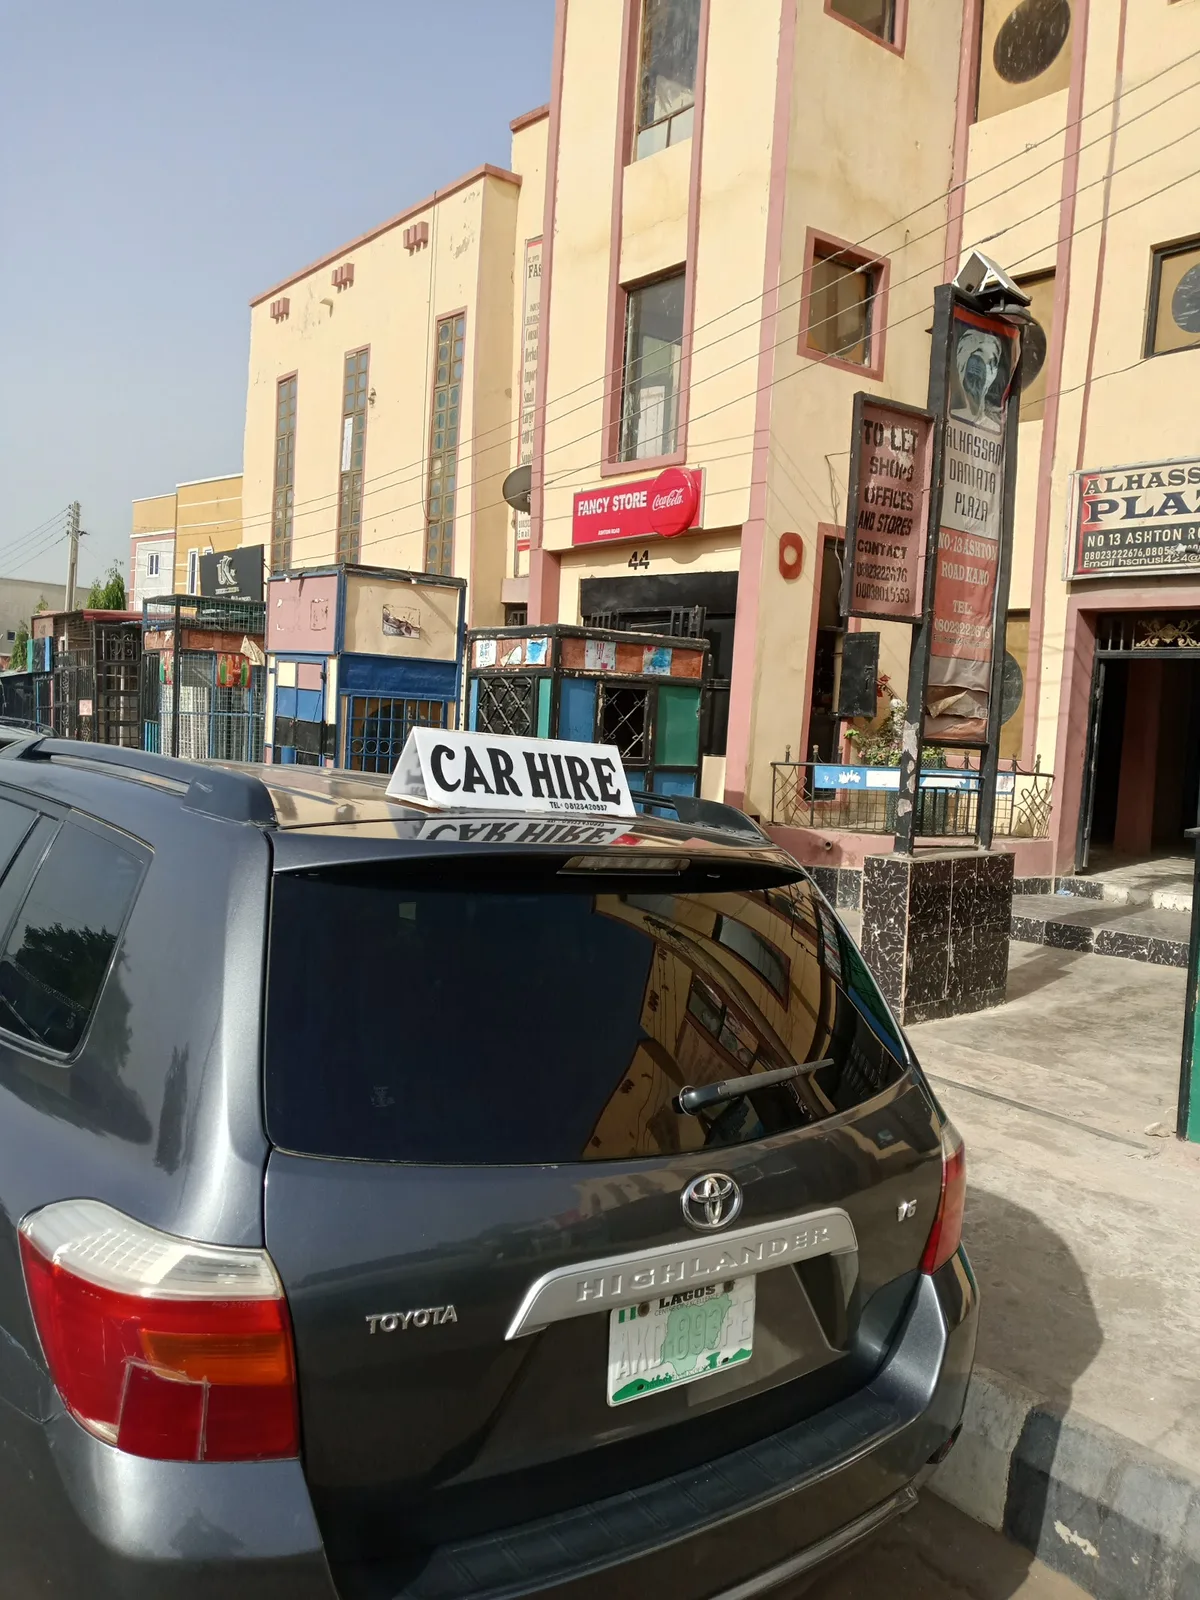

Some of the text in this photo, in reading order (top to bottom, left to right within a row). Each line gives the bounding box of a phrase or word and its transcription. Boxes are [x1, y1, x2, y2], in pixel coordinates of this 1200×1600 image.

[863, 419, 919, 454] TO LET
[946, 425, 1002, 466] ALHASSAN
[869, 456, 914, 482] SHOPS
[949, 457, 996, 495] DANTATA
[577, 496, 610, 516] FANCY
[612, 490, 648, 512] STORE
[864, 485, 913, 511] OFFICES
[954, 491, 988, 522] PLAZA
[1083, 490, 1200, 523] PLA
[858, 511, 913, 536] AND STORES
[857, 539, 908, 559] CONTACT
[963, 538, 998, 562] ASHTON
[1087, 535, 1104, 547] NO
[1108, 533, 1121, 546] 13
[1125, 528, 1182, 544] ASHTON
[627, 549, 650, 571] 44
[941, 560, 990, 586] ROAD KANO
[1083, 558, 1115, 568] Email
[430, 744, 621, 806] CAR HIRE
[576, 1227, 832, 1302] HIGHLANDER
[658, 1285, 716, 1309] LAGOS
[365, 1304, 458, 1335] TOYOTA
